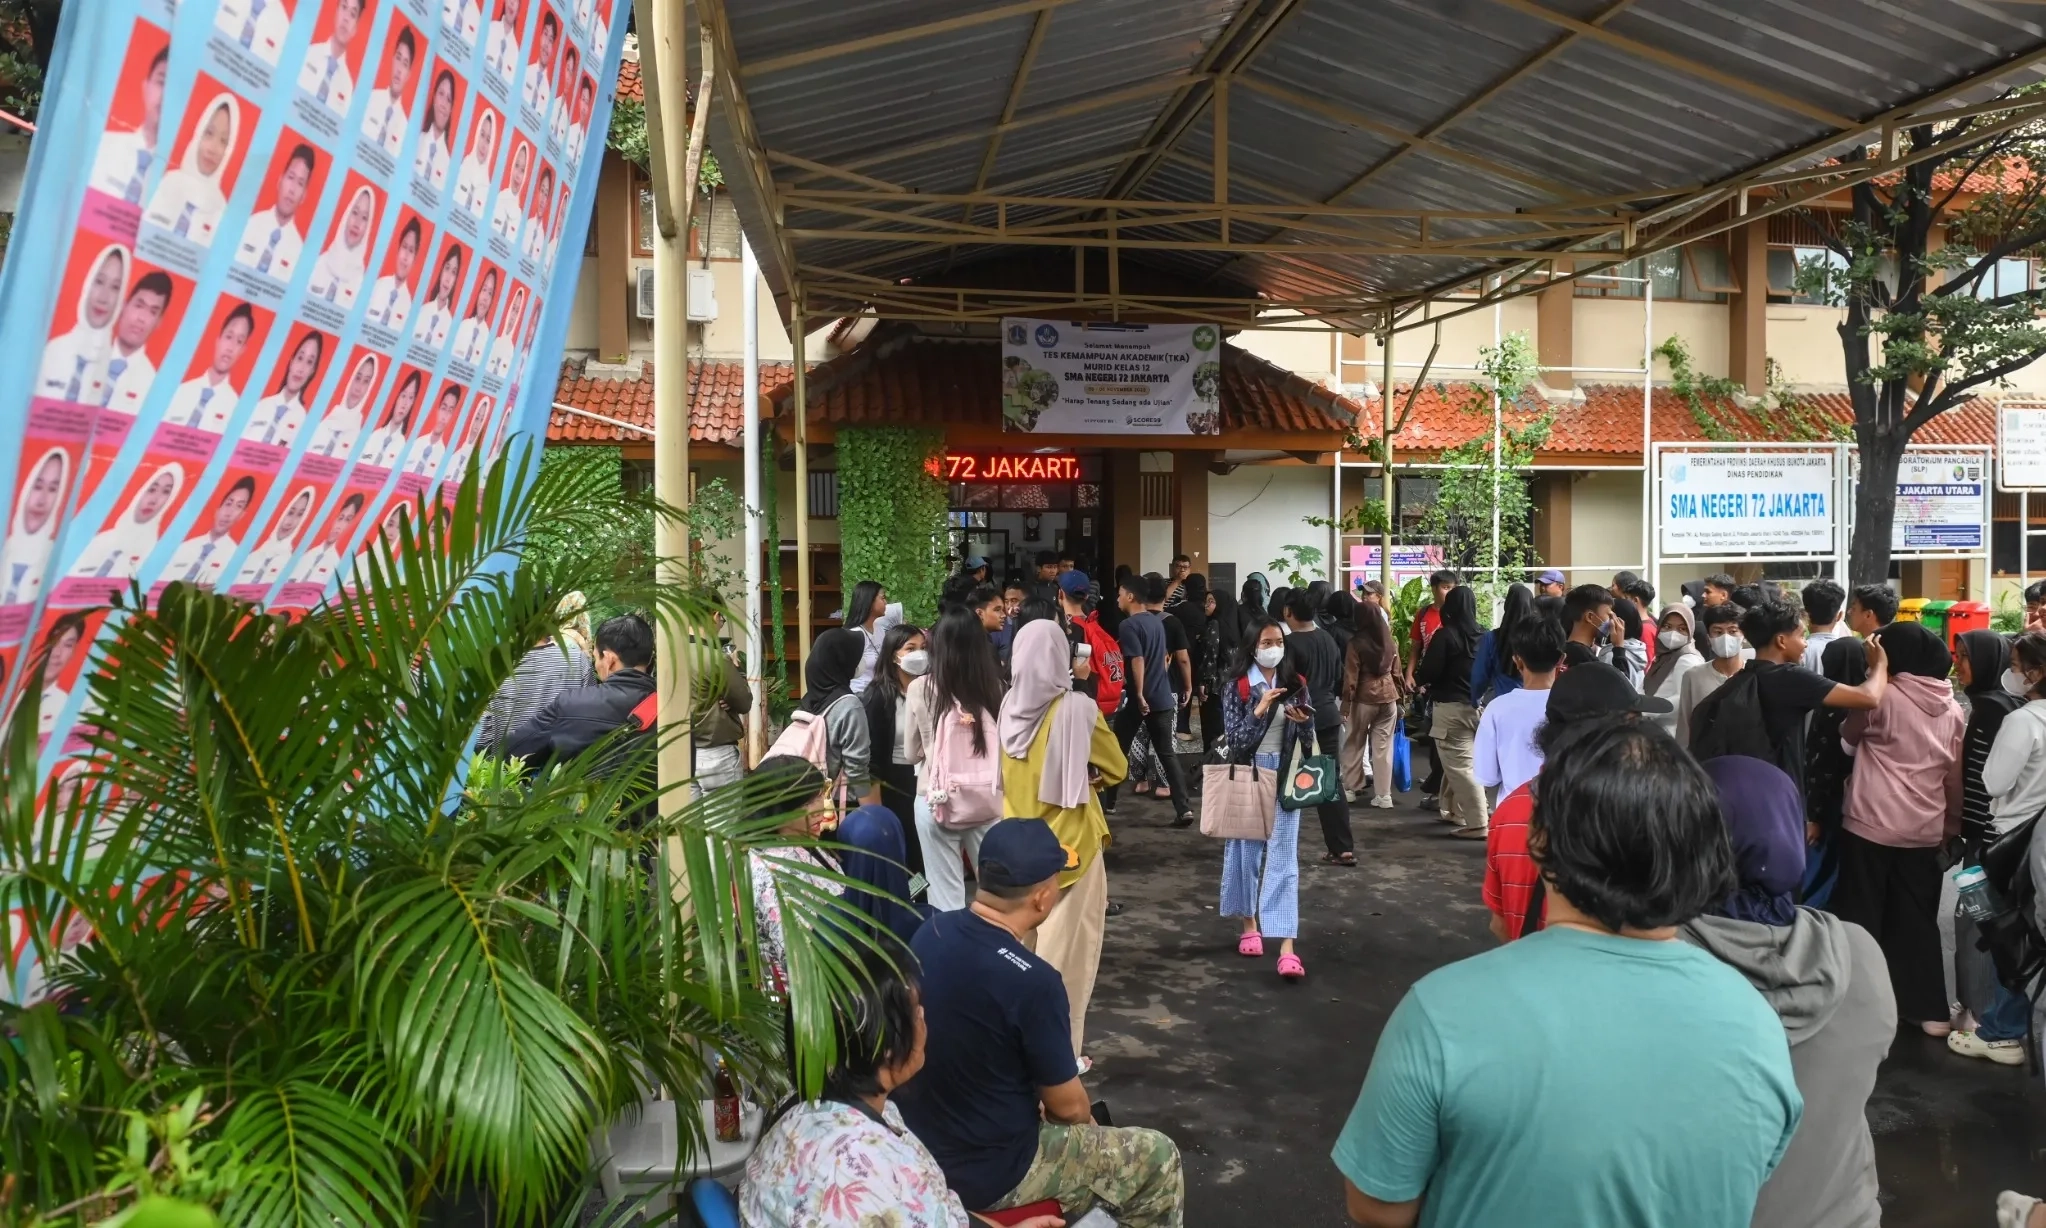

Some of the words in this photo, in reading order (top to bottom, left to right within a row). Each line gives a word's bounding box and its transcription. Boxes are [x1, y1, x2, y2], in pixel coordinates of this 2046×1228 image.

[1043, 351, 1059, 359] TES
[1060, 352, 1118, 361] KEMAMPUAN
[1084, 363, 1112, 371] MURID
[1142, 364, 1150, 372] 12
[1064, 372, 1084, 382] SMA
[1085, 373, 1118, 382] NEGERI
[1119, 373, 1130, 382] 72
[1130, 374, 1170, 383] JAKARTA
[1087, 398, 1110, 406] Tenang
[1112, 399, 1137, 407] Sedang
[1806, 457, 1826, 466] JAKARTA
[1944, 457, 1980, 465] PANCASILA
[946, 456, 976, 478] 72
[982, 457, 1079, 478] JAKART
[1911, 466, 1928, 474] (SLP)
[1727, 470, 1746, 478] DINAS
[1747, 470, 1783, 478] PENDIDIKAN
[1902, 486, 1944, 495] JAKARTA
[1945, 486, 1974, 495] UTARA
[1670, 494, 1697, 518] SMA
[1701, 494, 1748, 518] NEGERI
[1751, 494, 1765, 518] 72
[1768, 493, 1825, 517] JAKARTA
